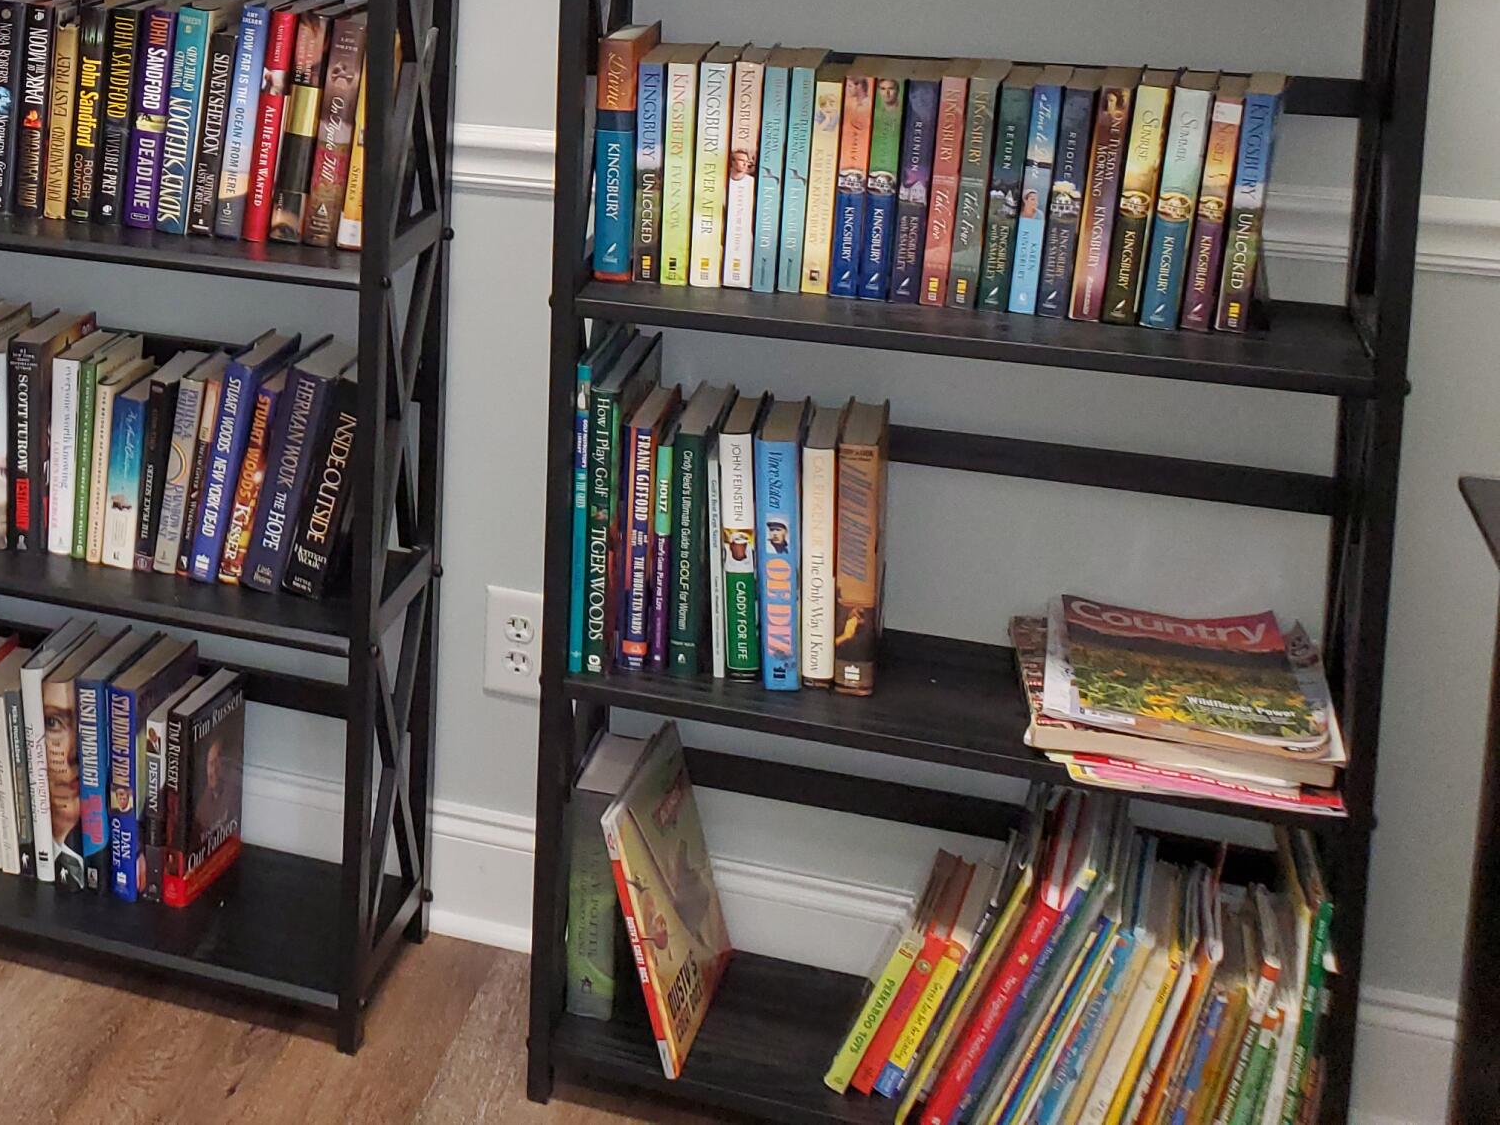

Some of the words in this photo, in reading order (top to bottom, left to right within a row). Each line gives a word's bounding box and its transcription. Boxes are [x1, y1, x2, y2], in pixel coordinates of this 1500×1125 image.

[82, 56, 101, 86] John
[142, 47, 166, 110] SANDFORD
[76, 89, 99, 149] Sandford
[641, 72, 660, 170] KINGSBURY
[133, 137, 156, 209] DEADLINE
[605, 142, 621, 222] KINGSBURY
[640, 173, 657, 244] UNLOCKED
[1116, 231, 1136, 291] KINGSBURY
[1155, 236, 1175, 295] KINGSBURY
[1230, 213, 1254, 290] UNLOCKED
[18, 374, 29, 423] SCOTT
[289, 379, 315, 441] HERMAN
[17, 426, 30, 473] TUROW
[277, 442, 301, 488] WOUK
[595, 439, 610, 465] Play
[730, 443, 741, 473] JOHN
[594, 467, 609, 498] Golf
[732, 476, 743, 522] FEINSTEIN
[224, 503, 251, 560] KISSER
[262, 510, 286, 552] HOPE
[591, 527, 608, 575] TIGER
[587, 577, 606, 640] WOODS
[735, 581, 746, 618] CADDY
[1070, 599, 1267, 646] Country
[737, 620, 747, 640] FOR
[737, 641, 748, 660] LIFE
[79, 688, 97, 722] RUSH
[79, 723, 99, 788] LIMBAUGH
[147, 761, 158, 812] DESTINY
[863, 978, 896, 1029] PEEKABOO
[850, 1032, 868, 1054] TOYS
